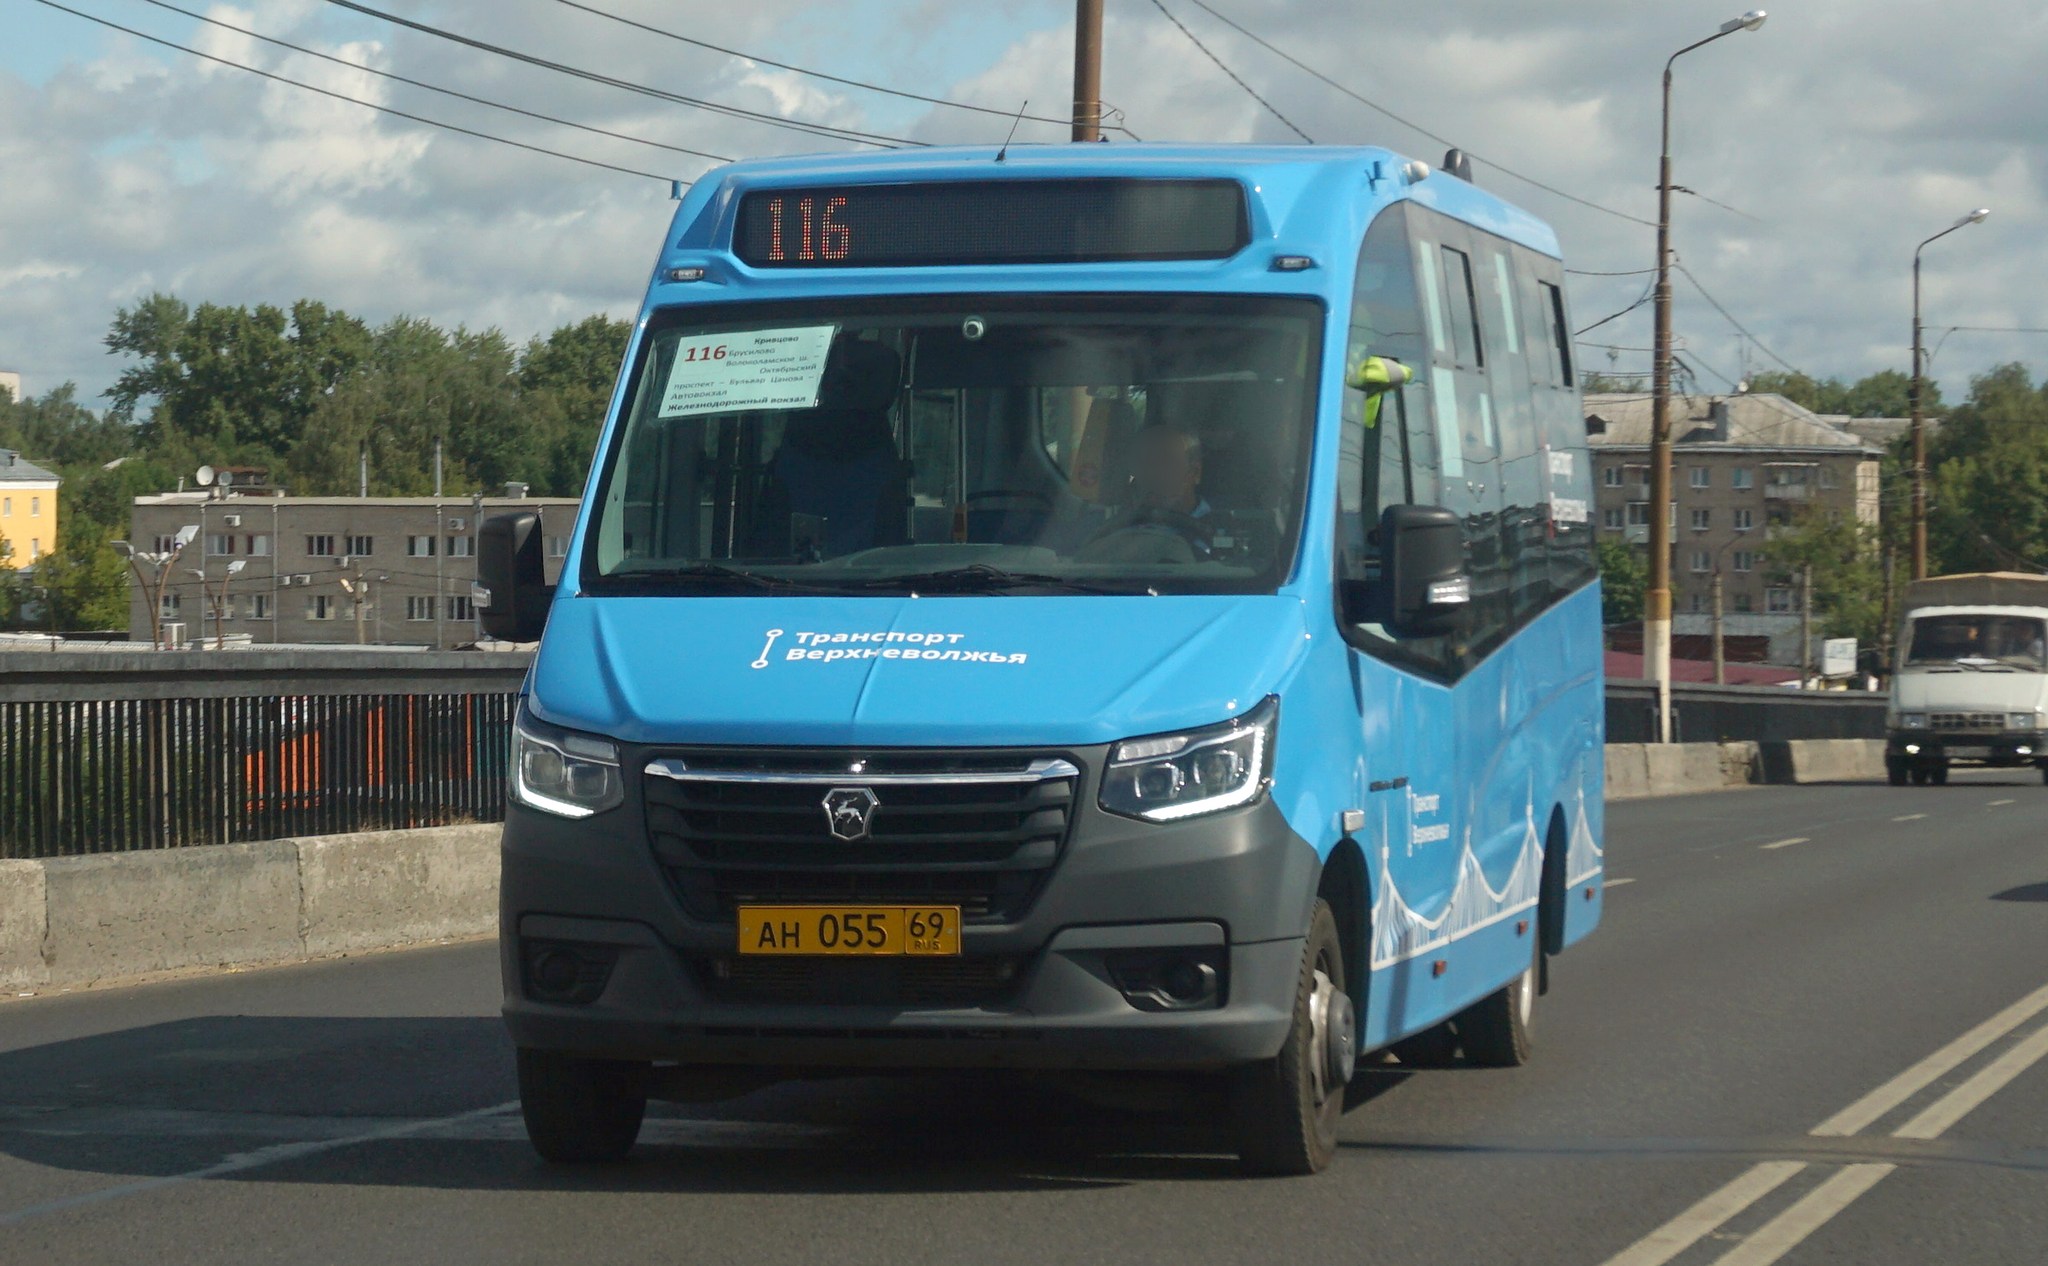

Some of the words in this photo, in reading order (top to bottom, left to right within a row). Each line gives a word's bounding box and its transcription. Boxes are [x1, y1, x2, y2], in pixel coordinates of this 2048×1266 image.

[768, 197, 850, 260] 116
[753, 336, 799, 345] Кривцово
[684, 345, 728, 362] 116
[728, 348, 776, 357] Брусилово
[760, 364, 817, 374] Октябрьский
[673, 381, 715, 390] проспект
[670, 390, 728, 400] Автовокзал
[667, 397, 768, 412] Железнодорожный
[770, 396, 806, 404] вокзал
[796, 632, 965, 647] Транспорт
[785, 647, 1028, 665] Верхневолжья
[818, 913, 888, 948] 055
[909, 911, 944, 938] 69
[914, 938, 941, 950] RUS
